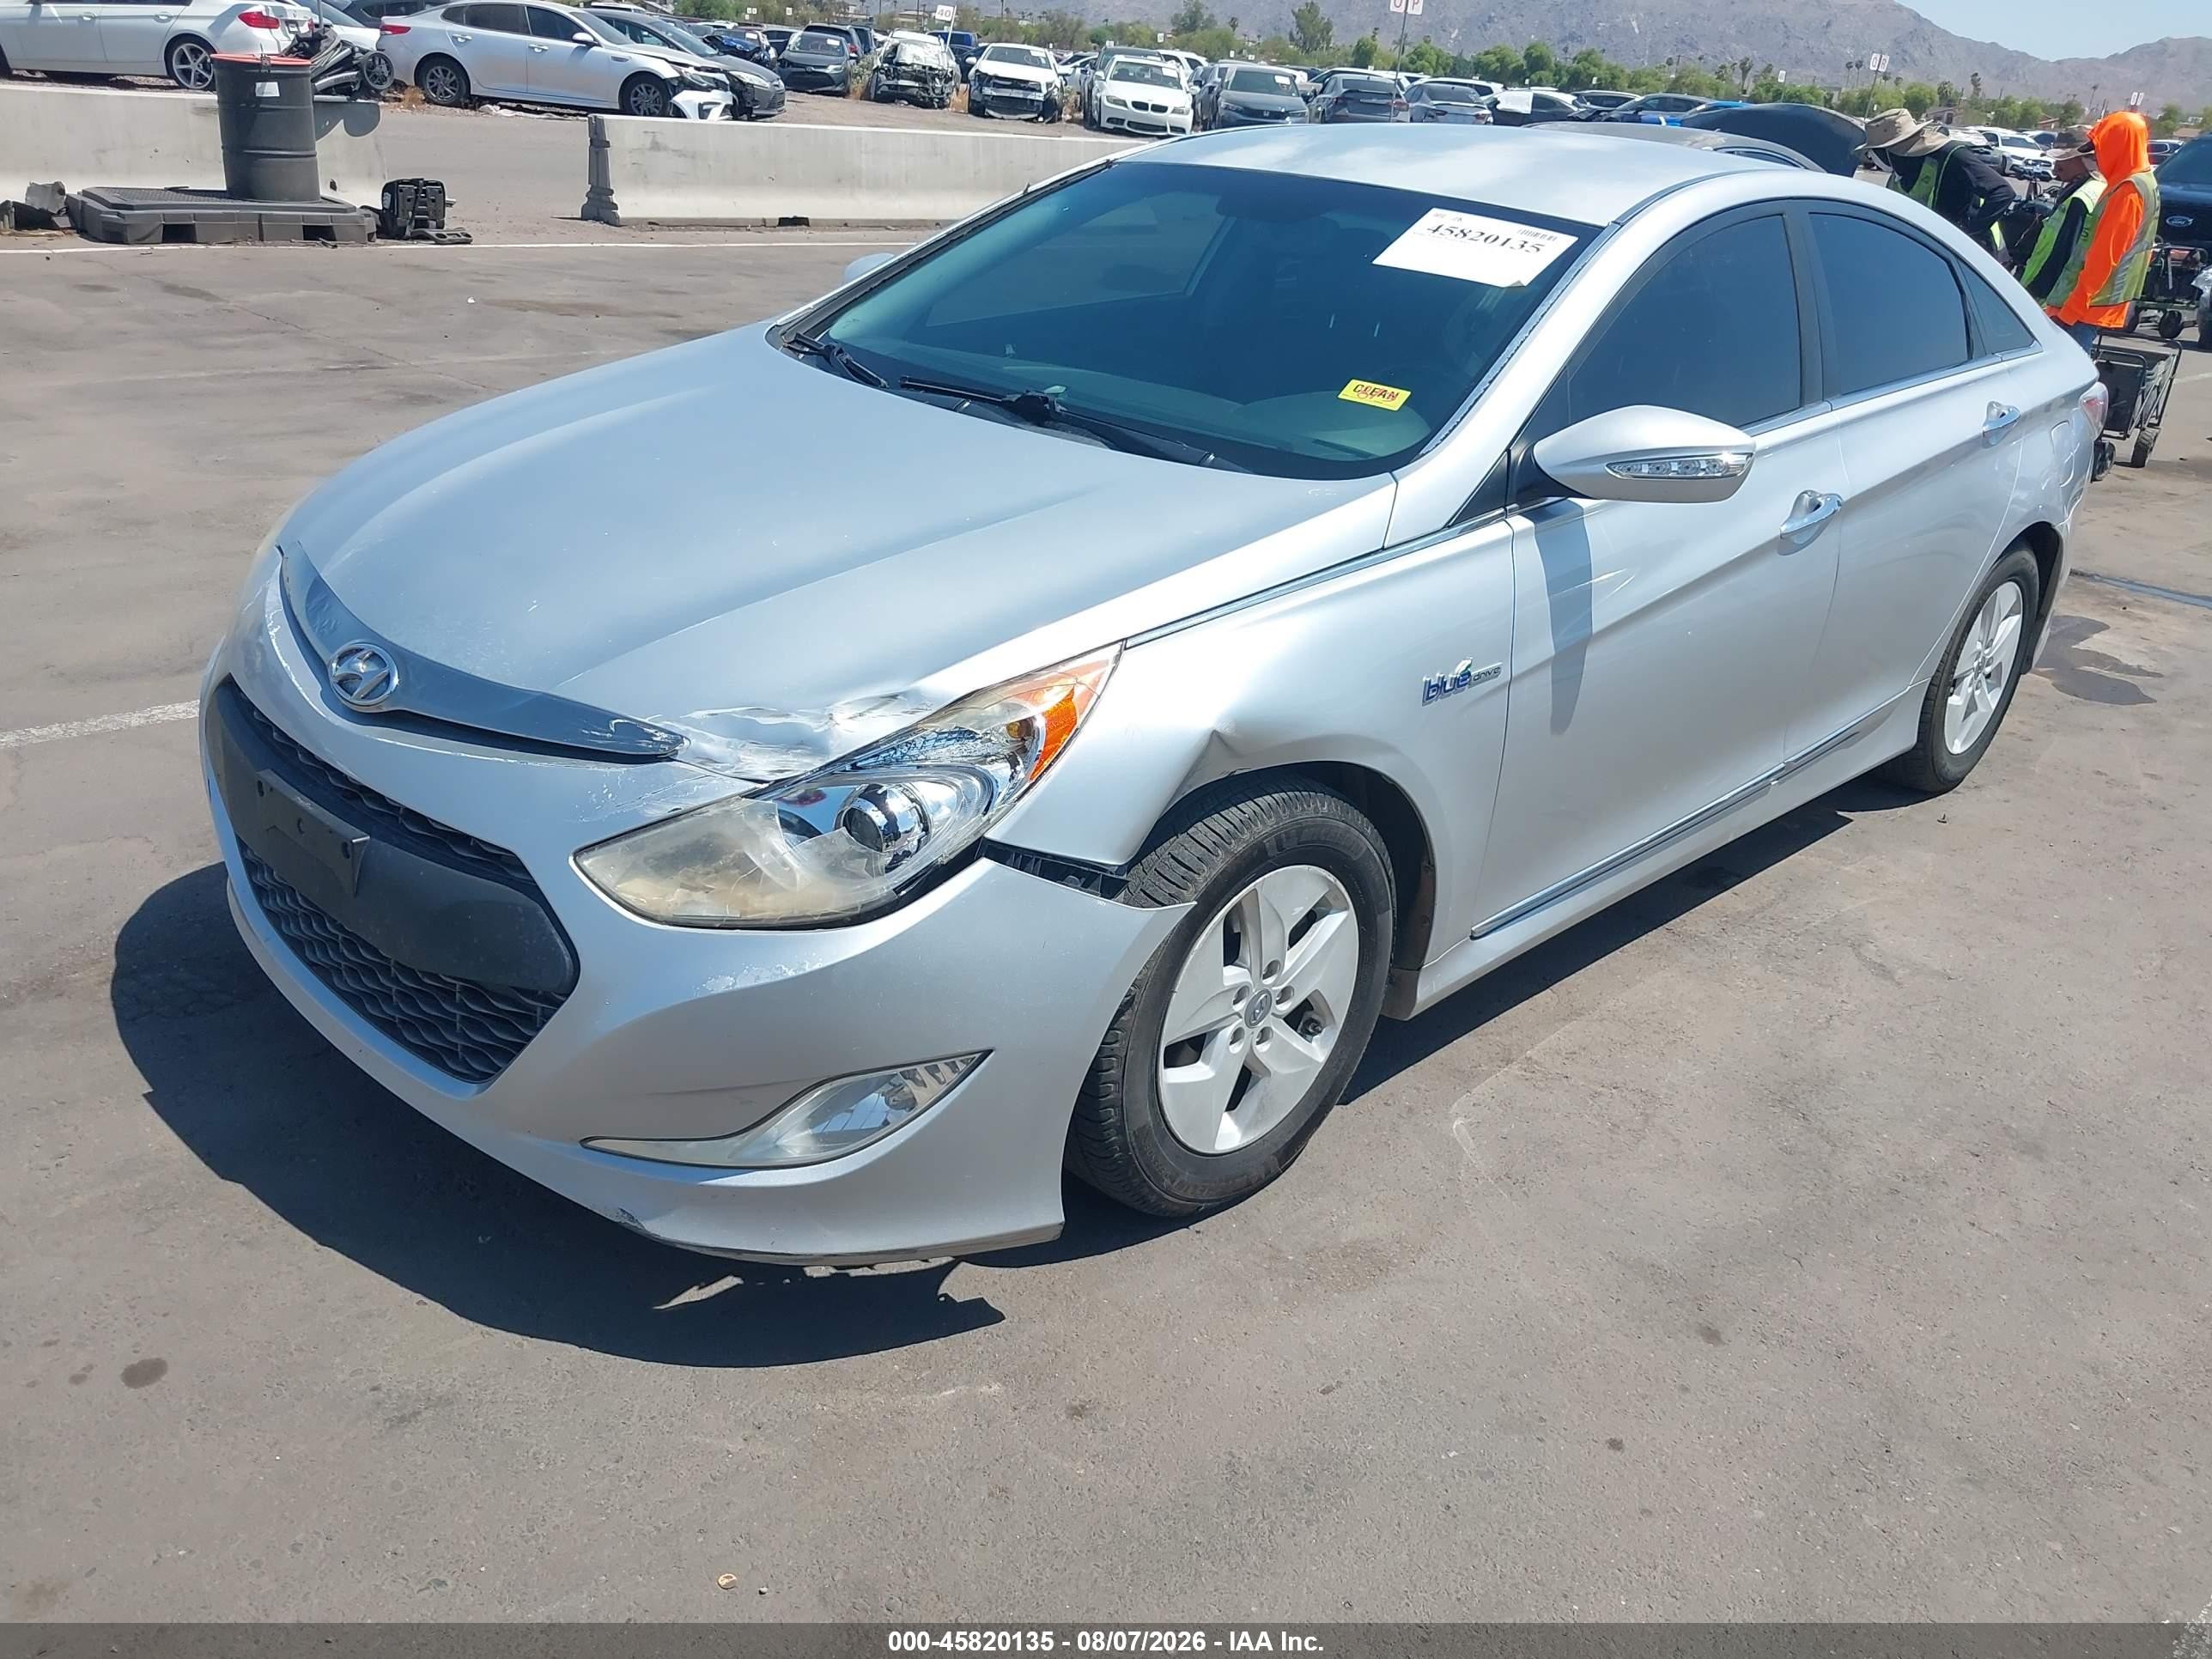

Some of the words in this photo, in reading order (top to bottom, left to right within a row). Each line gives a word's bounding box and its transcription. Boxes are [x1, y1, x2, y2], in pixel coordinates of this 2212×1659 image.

[1427, 223, 1546, 254] 45820135
[1422, 672, 1472, 704] blue
[1473, 666, 1502, 682] drive
